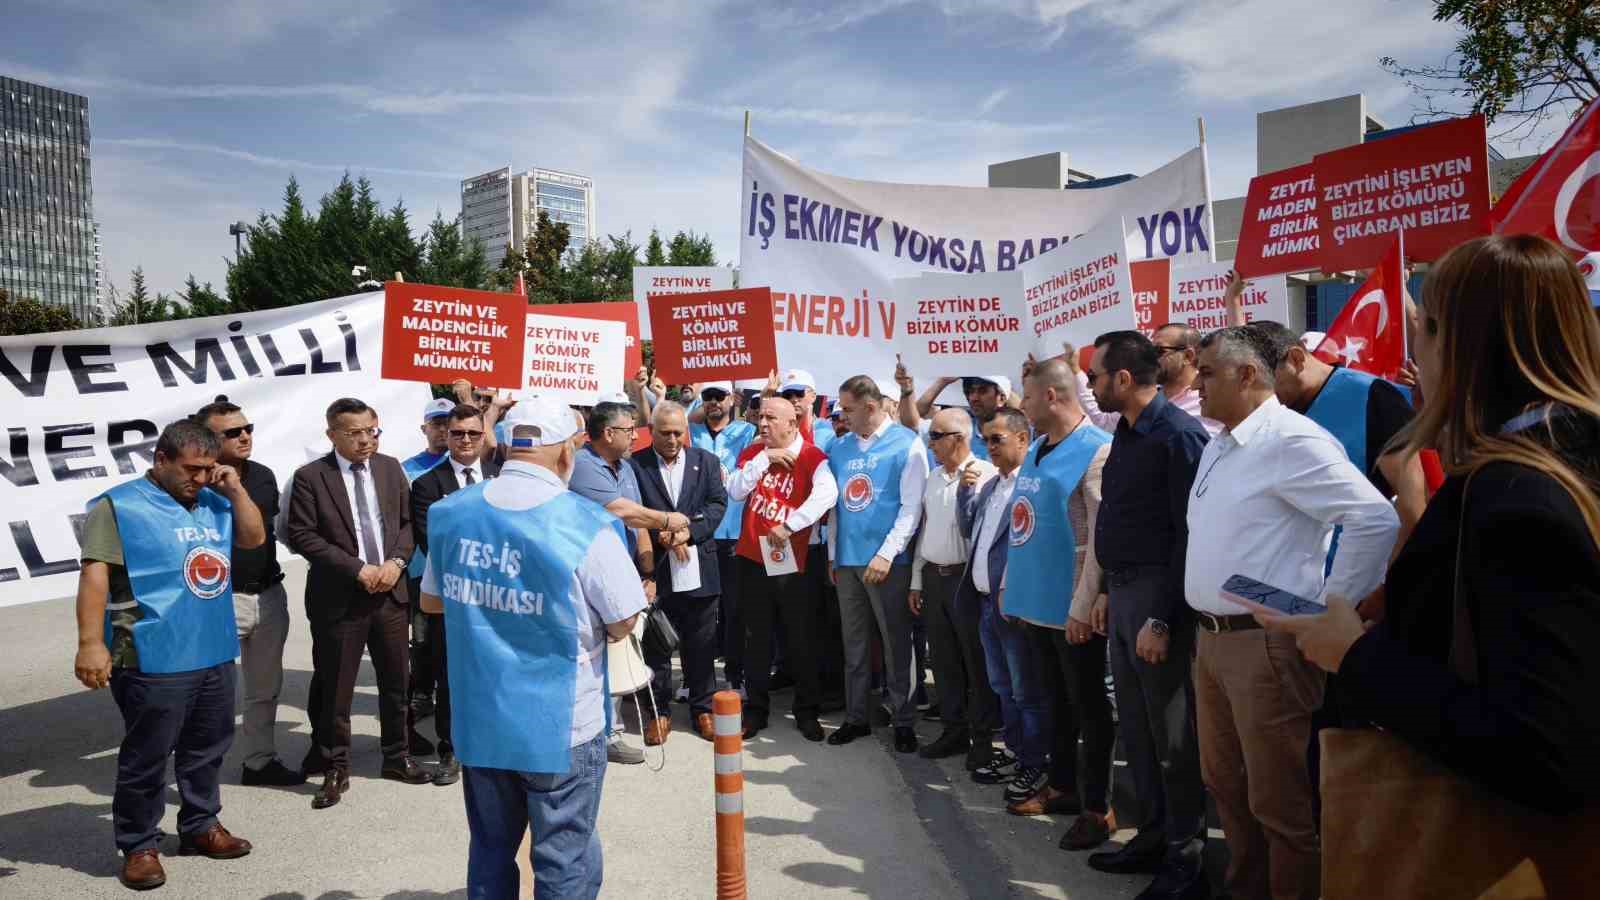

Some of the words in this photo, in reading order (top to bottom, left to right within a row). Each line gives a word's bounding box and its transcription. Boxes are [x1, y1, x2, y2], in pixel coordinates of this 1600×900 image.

[1269, 174, 1316, 201] ZEYTİ
[1323, 170, 1390, 201] ZEYTİNİ
[1393, 156, 1473, 190] İŞLEYEN
[1331, 198, 1377, 221] BİZİZ
[1378, 179, 1466, 212] KÖMÜRÜ
[749, 181, 776, 250] İŞ
[783, 194, 884, 252] EKMEK
[892, 221, 986, 274] YOKSA
[1137, 204, 1209, 258] YOK
[1333, 213, 1417, 246] ÇIKARAN
[1420, 201, 1472, 227] BİZİZ
[652, 275, 693, 288] ZEYTİN
[696, 277, 711, 288] VE
[1026, 271, 1068, 301] ZEYTİNİ
[1070, 252, 1118, 285] İŞLEYEN
[917, 295, 975, 316] ZEYTİN
[979, 297, 1001, 312] DE
[1032, 296, 1060, 317] BİZİZ
[1061, 271, 1115, 306] KÖMÜRÜ
[1172, 288, 1269, 313] MADENİLİK
[412, 298, 473, 317] ZEYTİN
[476, 304, 498, 319] VE
[672, 300, 724, 320] ZEYTİN
[725, 301, 747, 315] VE
[771, 288, 870, 338] ENERJİ
[1034, 304, 1087, 337] ÇIKARAN
[1089, 290, 1121, 314] BİZİZ
[402, 316, 509, 339] MADENCİLİK
[526, 326, 579, 341] ZEYTİN
[581, 331, 600, 344] VE
[682, 317, 739, 336] KÖMÜR
[906, 315, 952, 335] BİZİM
[955, 313, 1020, 333] KÖMÜR
[0, 344, 128, 397] VE
[145, 310, 362, 388] MİLLİ
[418, 332, 491, 355] BİRLİKTE
[535, 341, 591, 359] KÖMÜR
[681, 335, 747, 353] BİRLİKTE
[928, 340, 949, 354] DE
[952, 335, 999, 354] BİZİM
[413, 351, 494, 373] MÜMKÜN
[532, 357, 595, 375] BİRLİKTE
[682, 350, 752, 369] MÜMKÜN
[528, 373, 599, 391] MÜMKÜN
[760, 472, 795, 500] ES-İŞ
[458, 537, 522, 579] TES-İŞ
[442, 572, 544, 616] SENDİKASI
